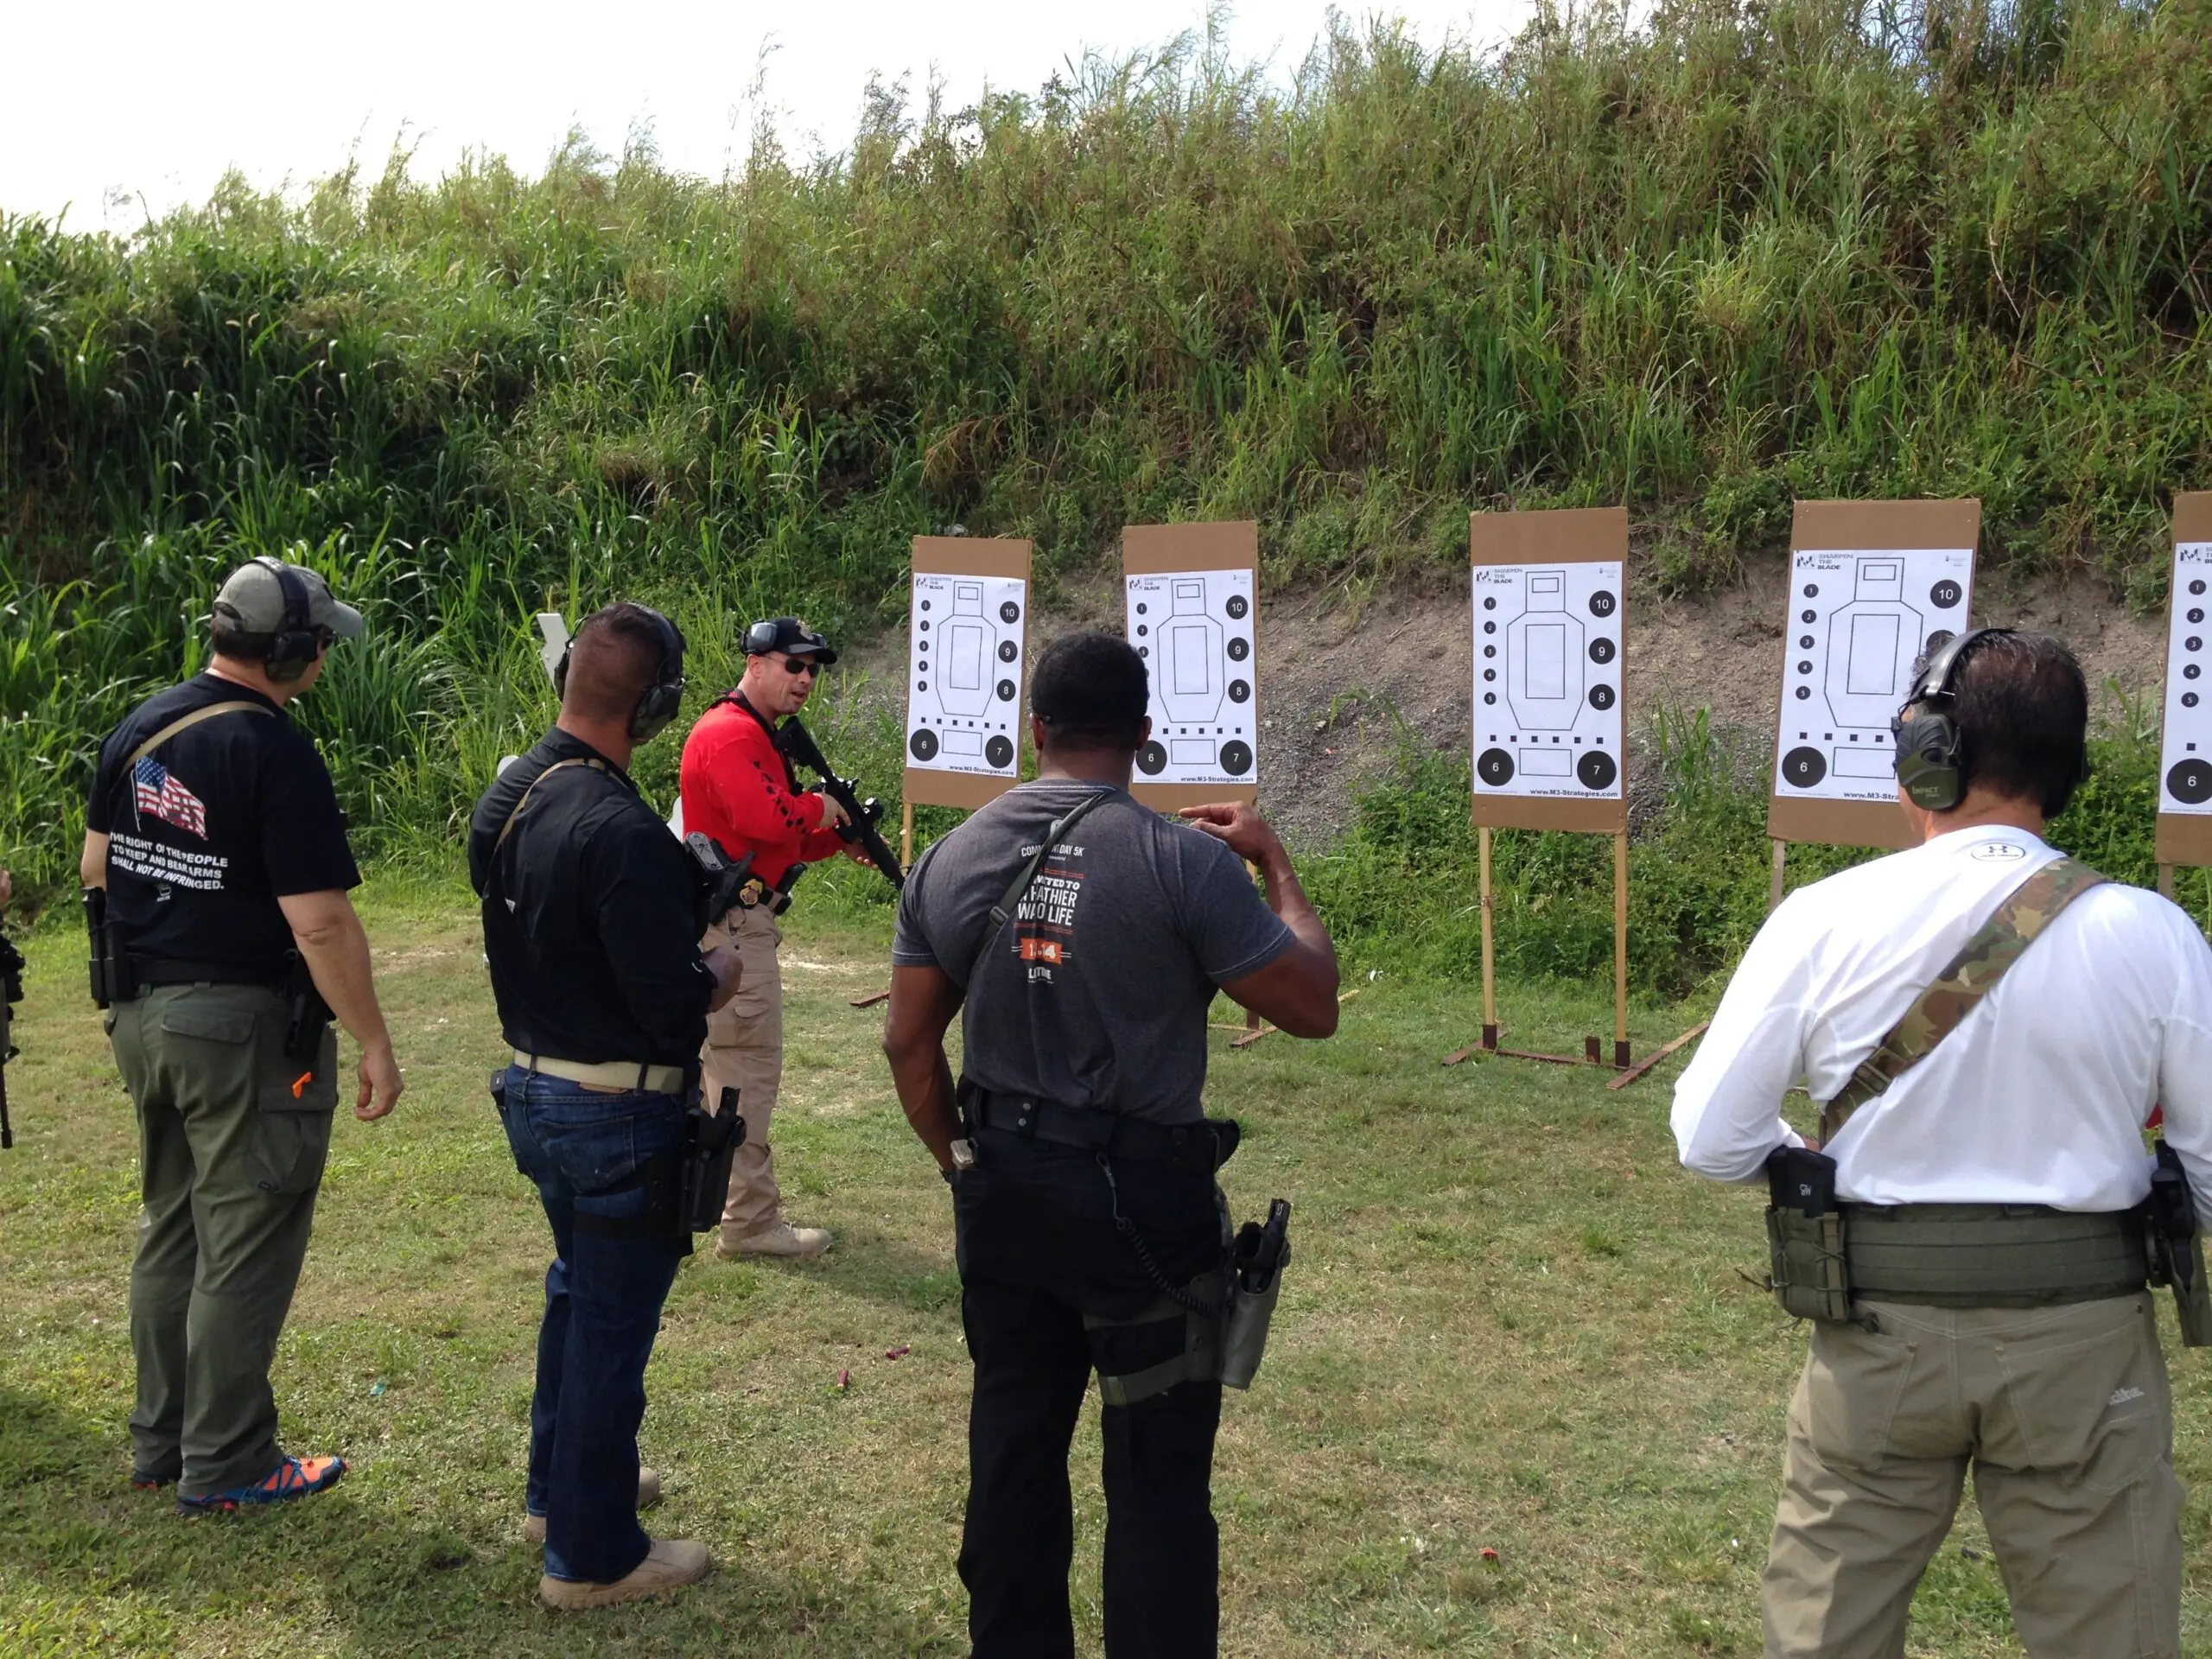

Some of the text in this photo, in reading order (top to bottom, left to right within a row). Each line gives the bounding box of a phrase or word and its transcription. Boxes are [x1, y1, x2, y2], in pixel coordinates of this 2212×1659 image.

[1939, 588, 1953, 599] 10
[1231, 603, 1243, 612] 10
[1597, 600, 1609, 609] 10
[1005, 608, 1015, 617] 10
[1005, 648, 1011, 657] 9
[1236, 645, 1241, 655] 9
[1599, 647, 1605, 657] 9
[1003, 686, 1009, 695] 8
[1236, 687, 1242, 696] 8
[1599, 692, 1605, 702] 8
[921, 741, 927, 749] 6
[997, 747, 1002, 756] 7
[1148, 753, 1154, 762] 6
[1233, 753, 1239, 762] 7
[1492, 762, 1499, 772] 6
[1593, 765, 1600, 775] 7
[1800, 762, 1808, 772] 6
[2188, 776, 2196, 786] 6
[1529, 788, 1618, 798] www.M3-Strategies.com
[110, 831, 228, 868] THE RIGHT OF THE PEOPLE
[1059, 843, 1073, 855] DAY
[1073, 846, 1085, 857] 5K
[111, 843, 222, 879] TO KEEP AND BEAR ARMS
[111, 855, 225, 890] SHALL NOT BE INFRINGED.
[1064, 880, 1080, 891] TO
[1047, 905, 1074, 926] LIFE
